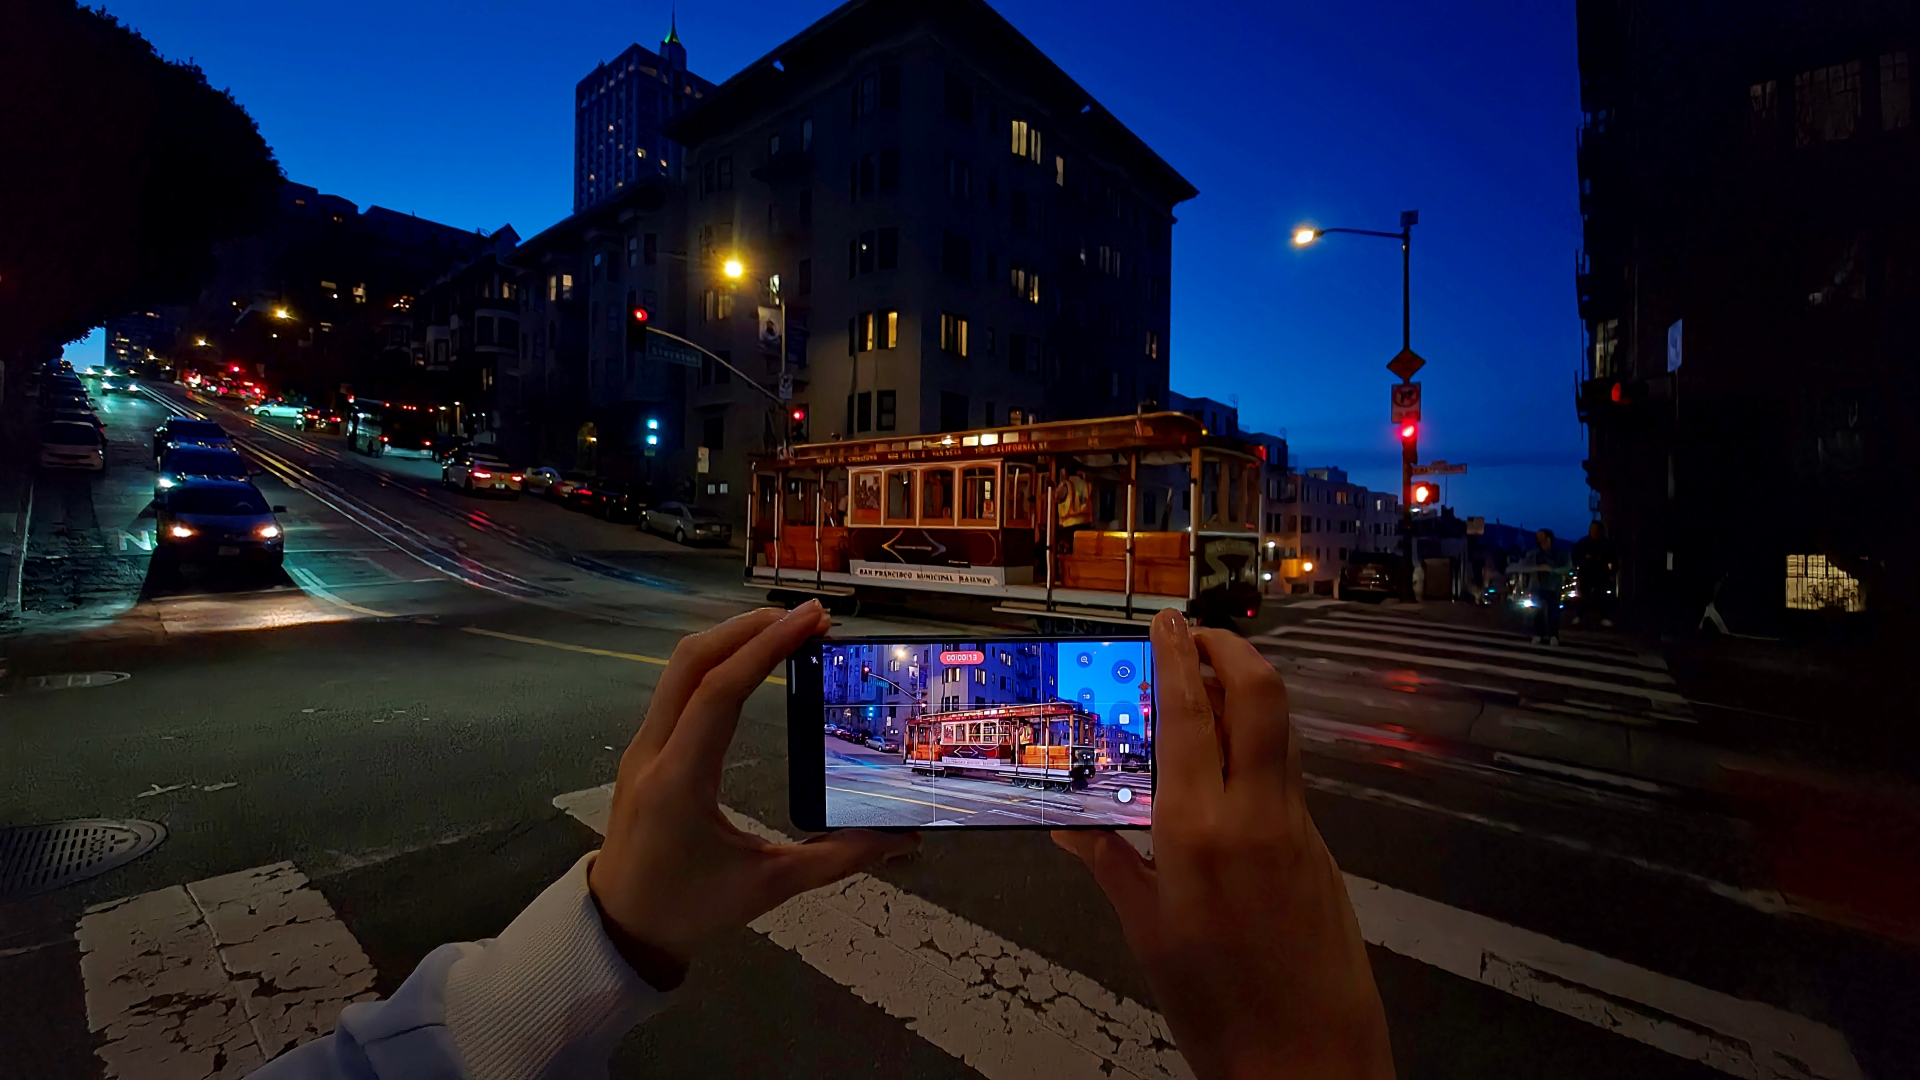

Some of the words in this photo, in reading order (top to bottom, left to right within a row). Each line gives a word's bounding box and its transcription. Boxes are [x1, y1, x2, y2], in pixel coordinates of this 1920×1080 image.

[859, 568, 873, 576] SAN
[874, 570, 913, 579] FRANCISCO
[916, 572, 954, 582] MUNICIPAL
[958, 575, 991, 584] RAILWAY
